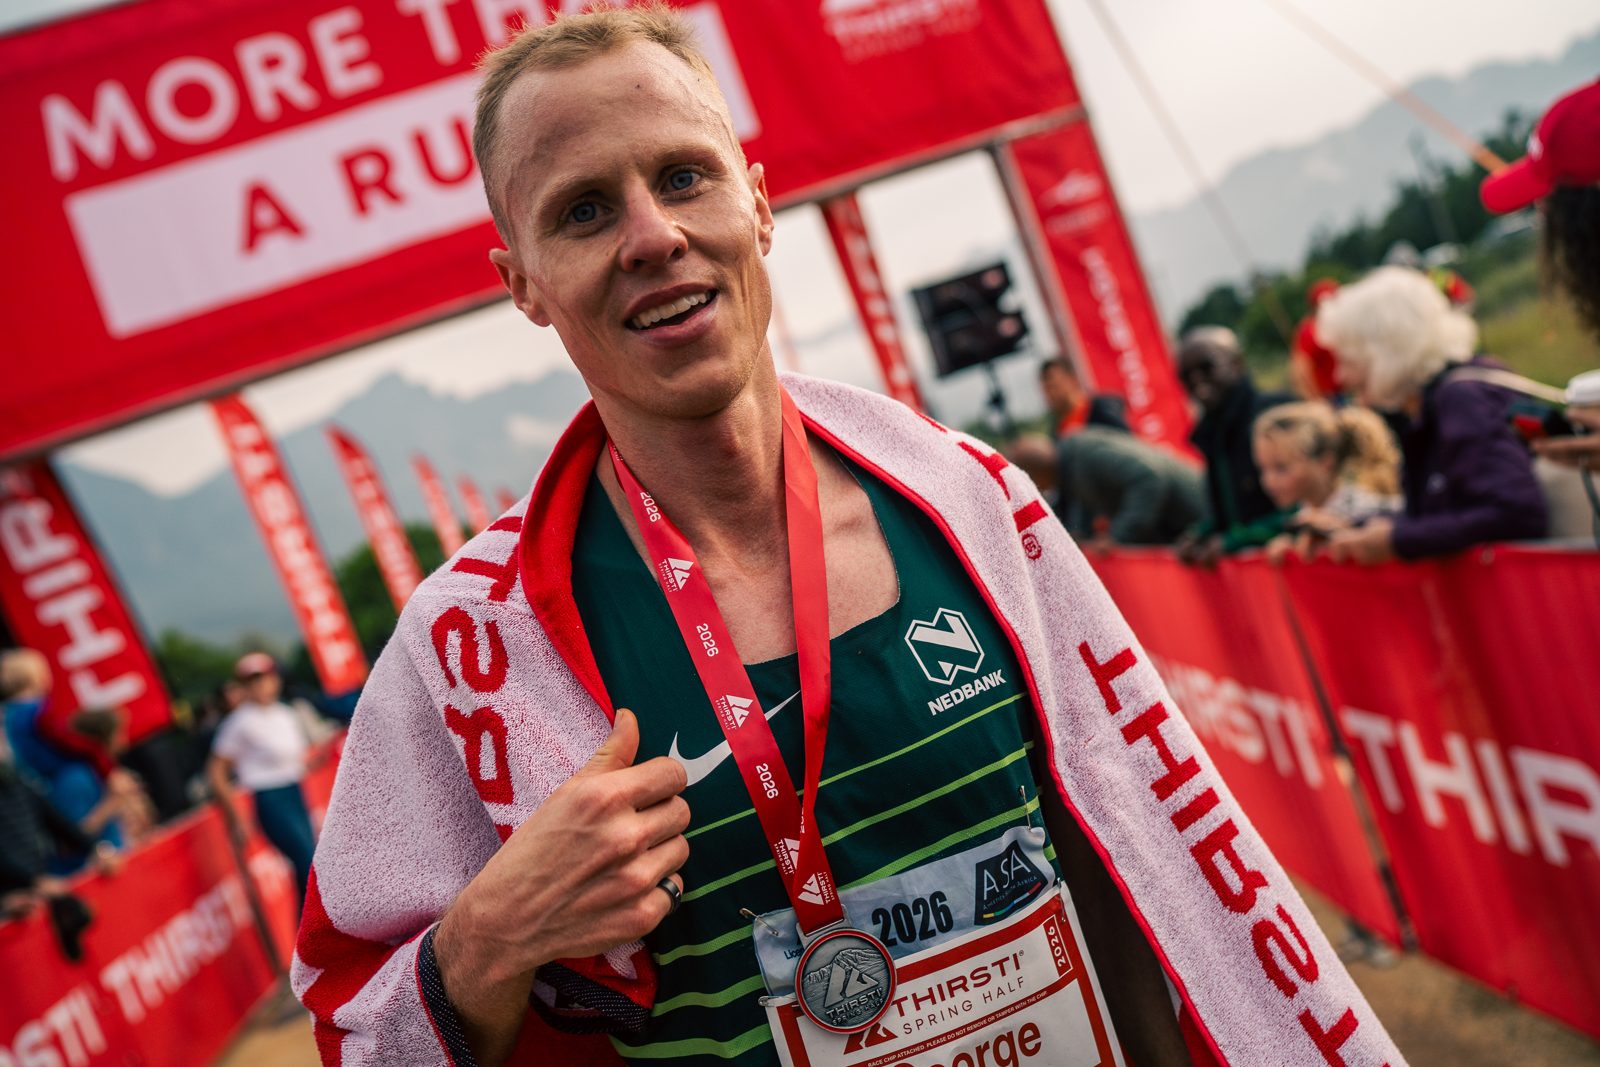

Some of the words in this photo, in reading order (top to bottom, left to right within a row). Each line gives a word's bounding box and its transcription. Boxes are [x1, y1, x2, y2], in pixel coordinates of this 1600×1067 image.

[40, 6, 384, 182] MORE
[240, 178, 308, 258] A
[335, 116, 476, 217] RU
[640, 491, 662, 523] 2026
[662, 559, 678, 592] THIRSTI
[0, 494, 148, 712] THIR
[696, 623, 719, 657] 2026
[720, 696, 737, 730] THIRSTI
[927, 669, 1007, 716] NEDBANK
[756, 763, 779, 799] 2026
[1338, 704, 1600, 868] THIR
[778, 839, 795, 875] THIRSTI
[983, 849, 1031, 901] ASA
[871, 890, 954, 947] 2026
[1047, 926, 1067, 968] 2026
[902, 999, 973, 1035] SPRING
[982, 976, 1025, 1005] HALF
[926, 1036, 947, 1048] PLEASE
[955, 1028, 966, 1037] NOT
[966, 1019, 987, 1032] REMOVE
